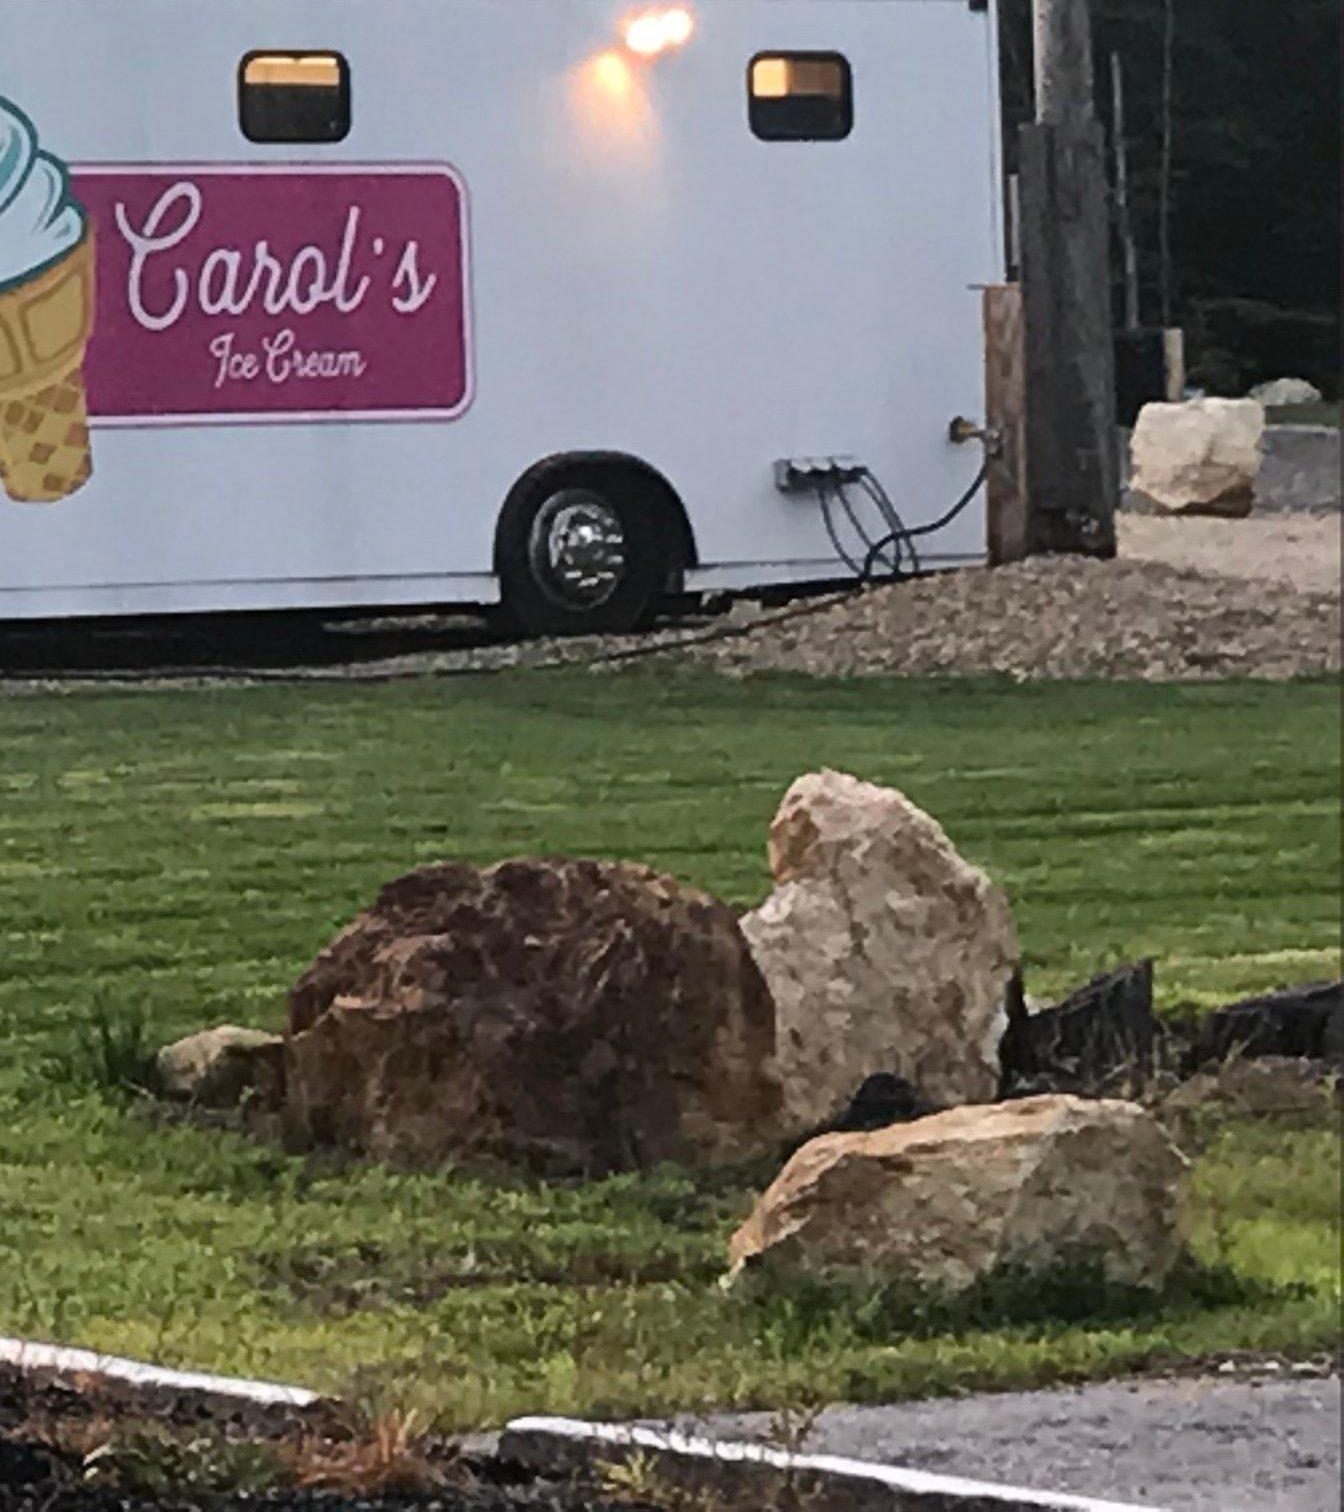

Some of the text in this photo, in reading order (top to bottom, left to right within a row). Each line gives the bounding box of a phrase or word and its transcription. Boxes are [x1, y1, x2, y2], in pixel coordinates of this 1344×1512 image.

[114, 181, 438, 331] Carol's
[209, 329, 367, 388] Ice Cream
